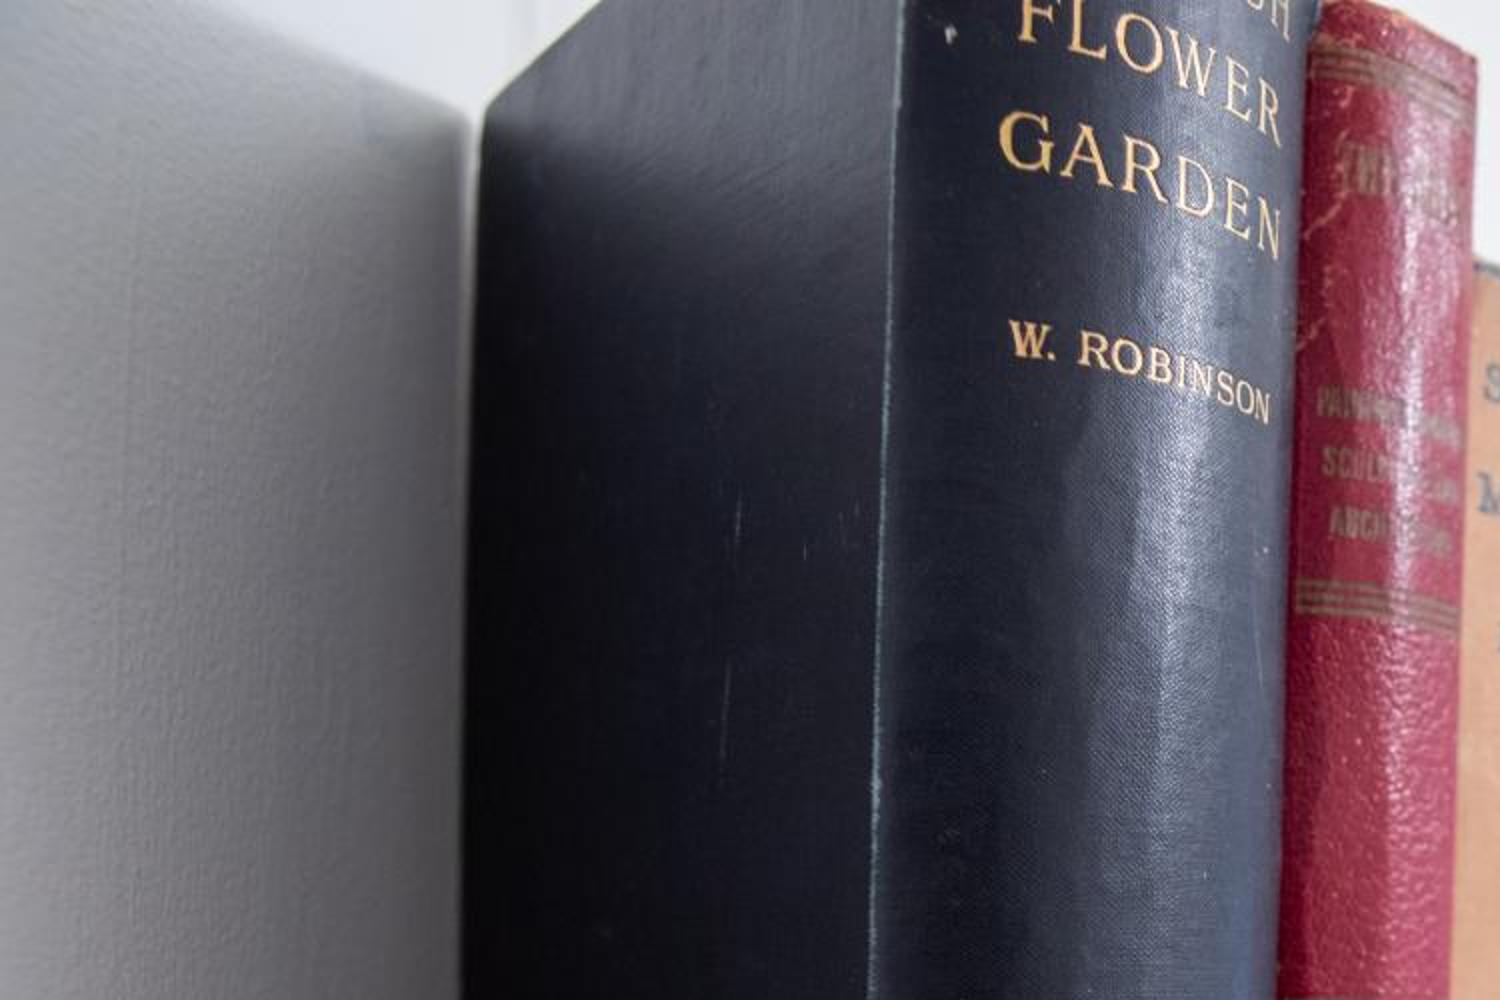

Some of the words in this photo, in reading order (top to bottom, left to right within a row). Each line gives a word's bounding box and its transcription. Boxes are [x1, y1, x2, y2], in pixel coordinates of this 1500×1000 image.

[1017, 0, 1282, 148] FLOWER
[999, 110, 1282, 263] GARDEN
[1008, 319, 1057, 361] W.
[1077, 330, 1272, 425] ROBINSON
